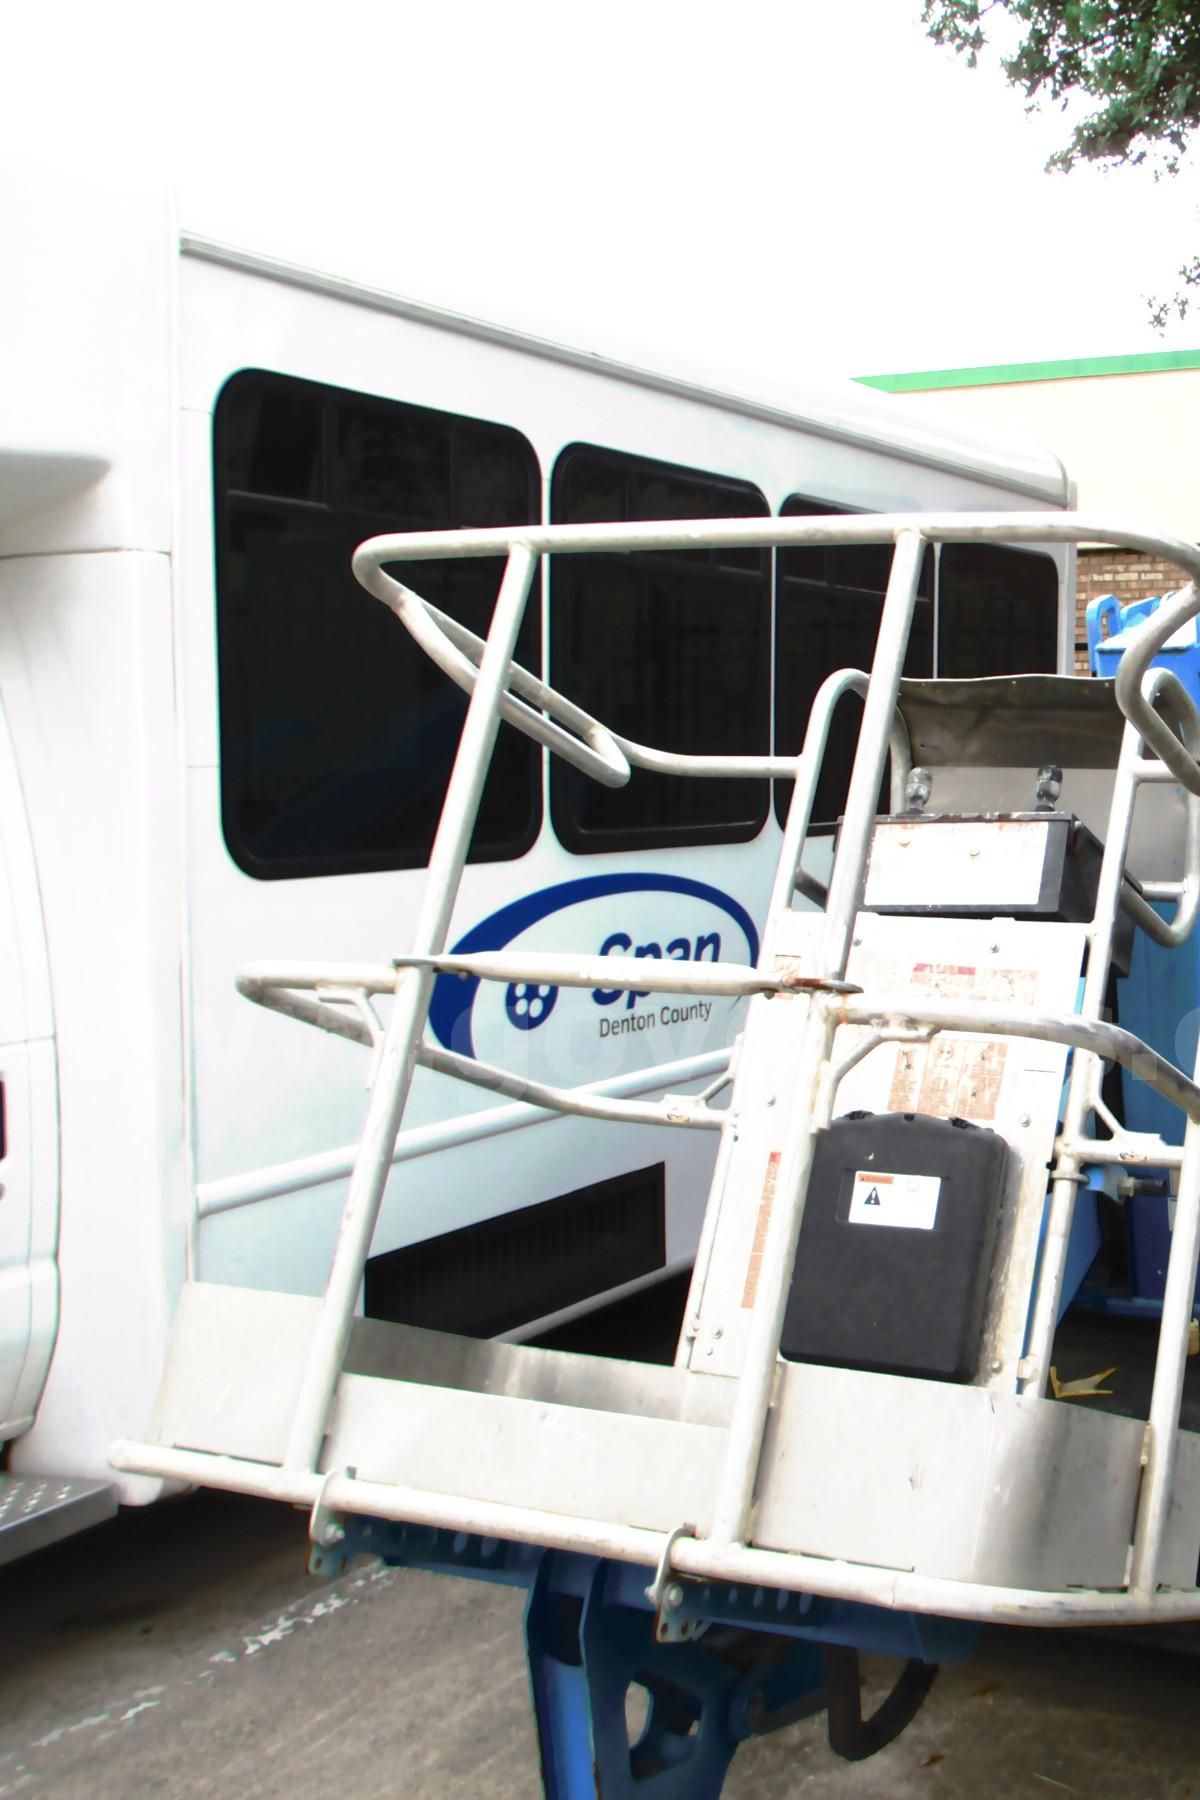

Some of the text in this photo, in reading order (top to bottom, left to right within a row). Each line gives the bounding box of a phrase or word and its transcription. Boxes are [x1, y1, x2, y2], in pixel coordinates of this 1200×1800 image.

[592, 931, 721, 1010] Span
[600, 1001, 713, 1038] Denton County
